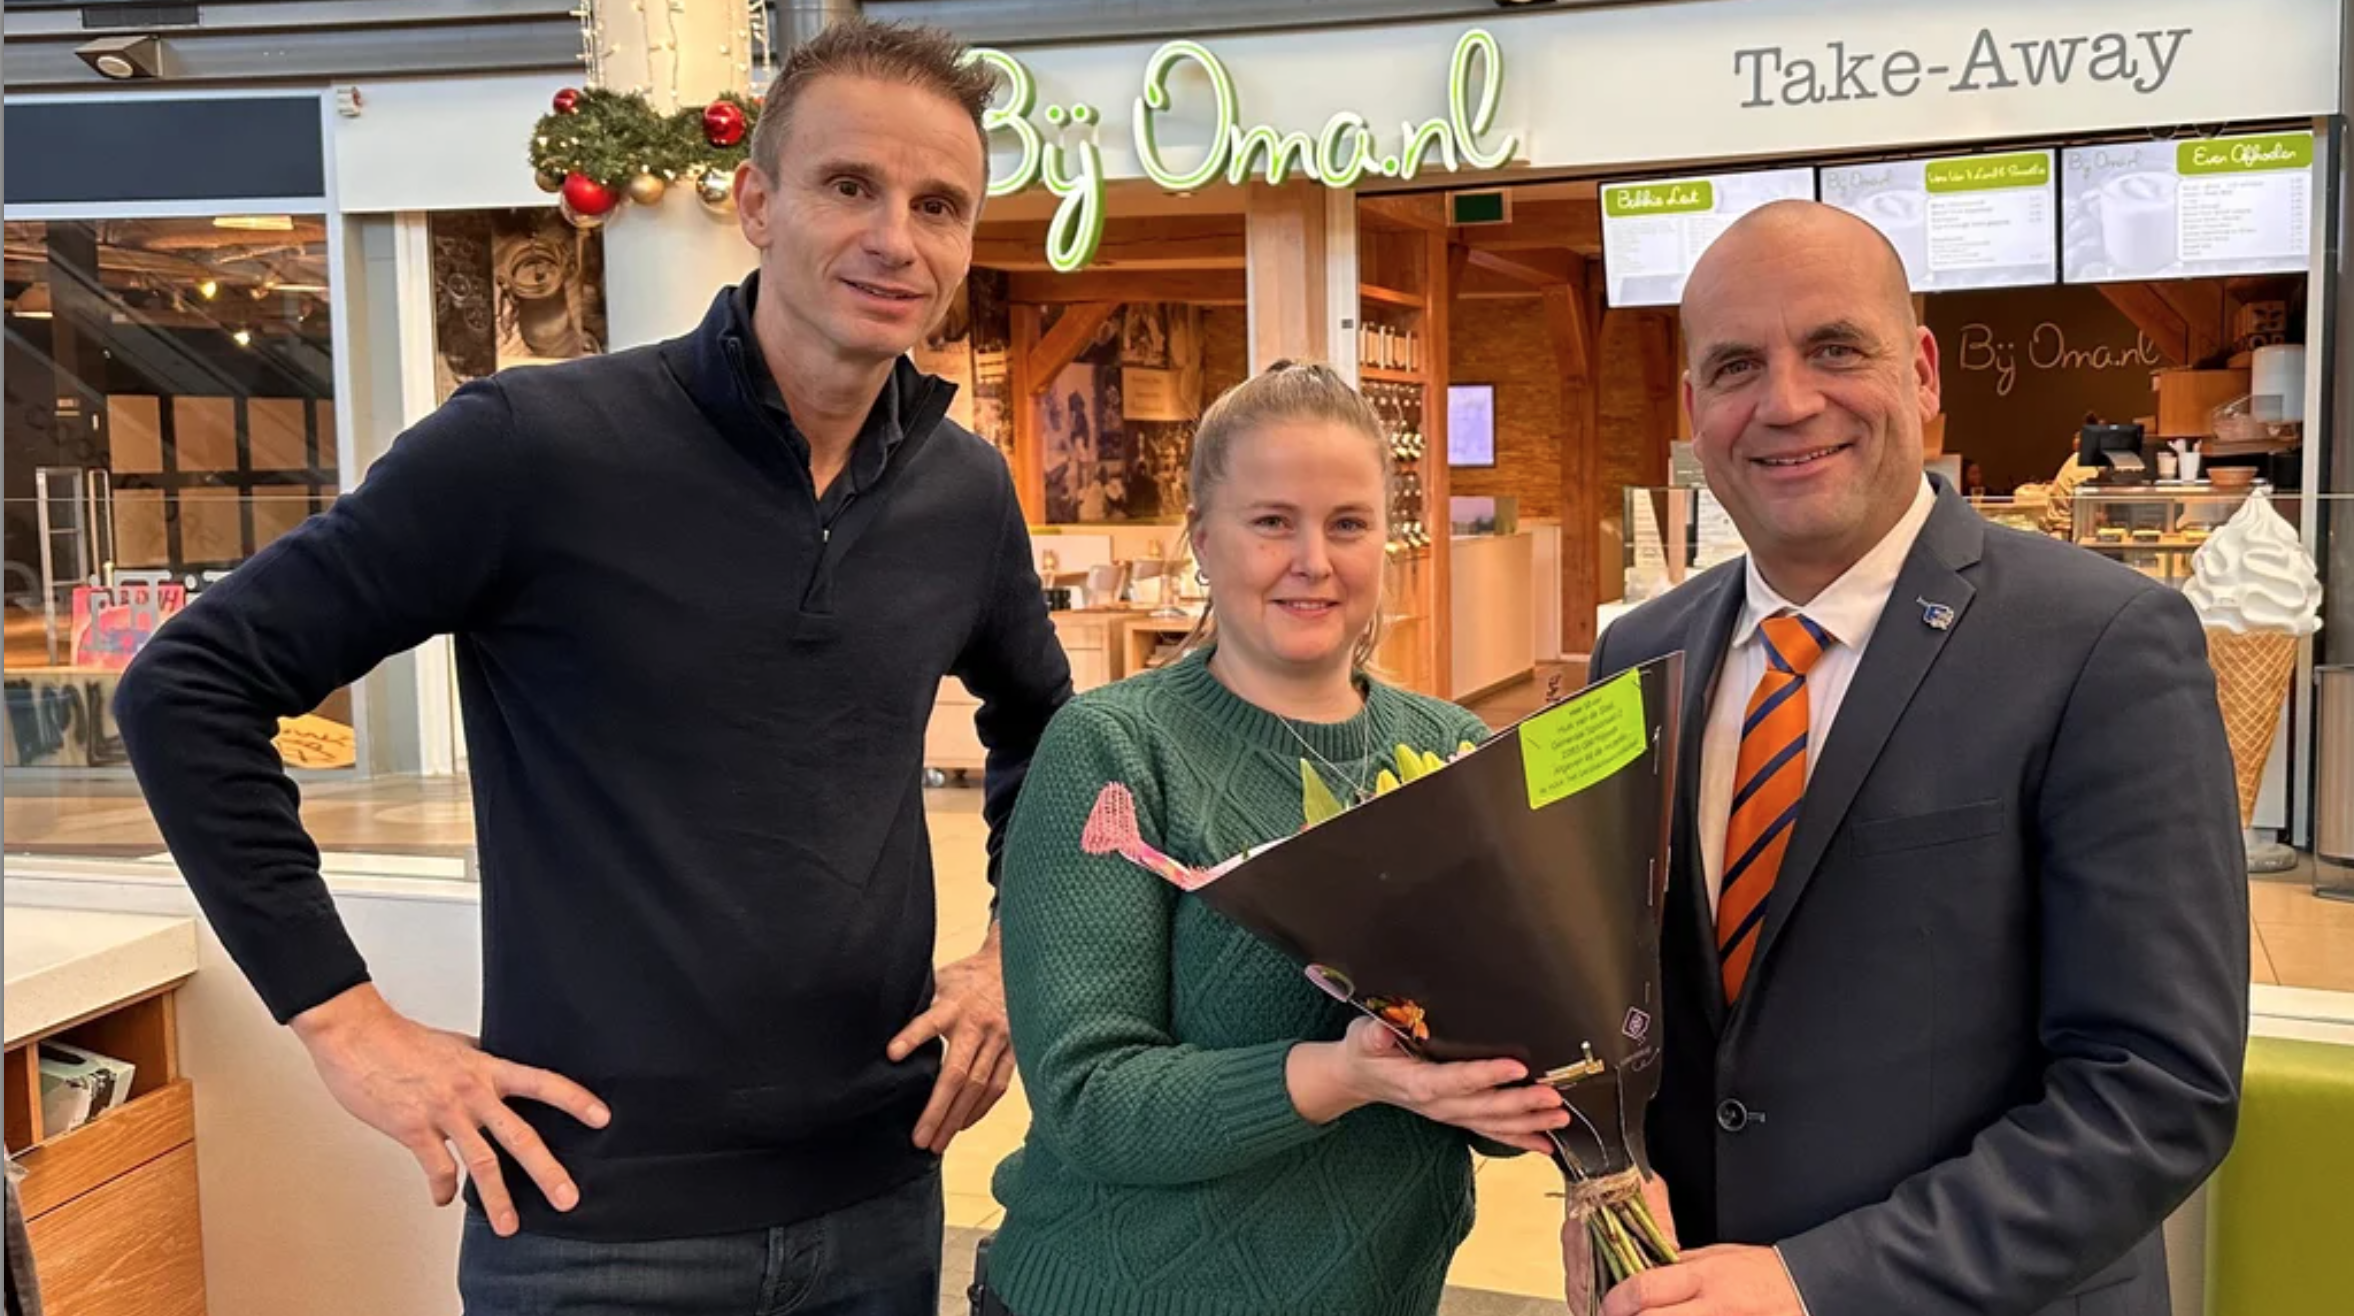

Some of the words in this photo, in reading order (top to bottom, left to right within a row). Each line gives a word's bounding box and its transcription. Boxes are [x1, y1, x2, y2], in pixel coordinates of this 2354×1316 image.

[1733, 27, 2194, 109] Take-Away
[957, 47, 1106, 272] Bij
[1133, 28, 1519, 189] Oma.nl
[1959, 323, 2017, 396] Bij
[2028, 322, 2160, 369] Oma.nl
